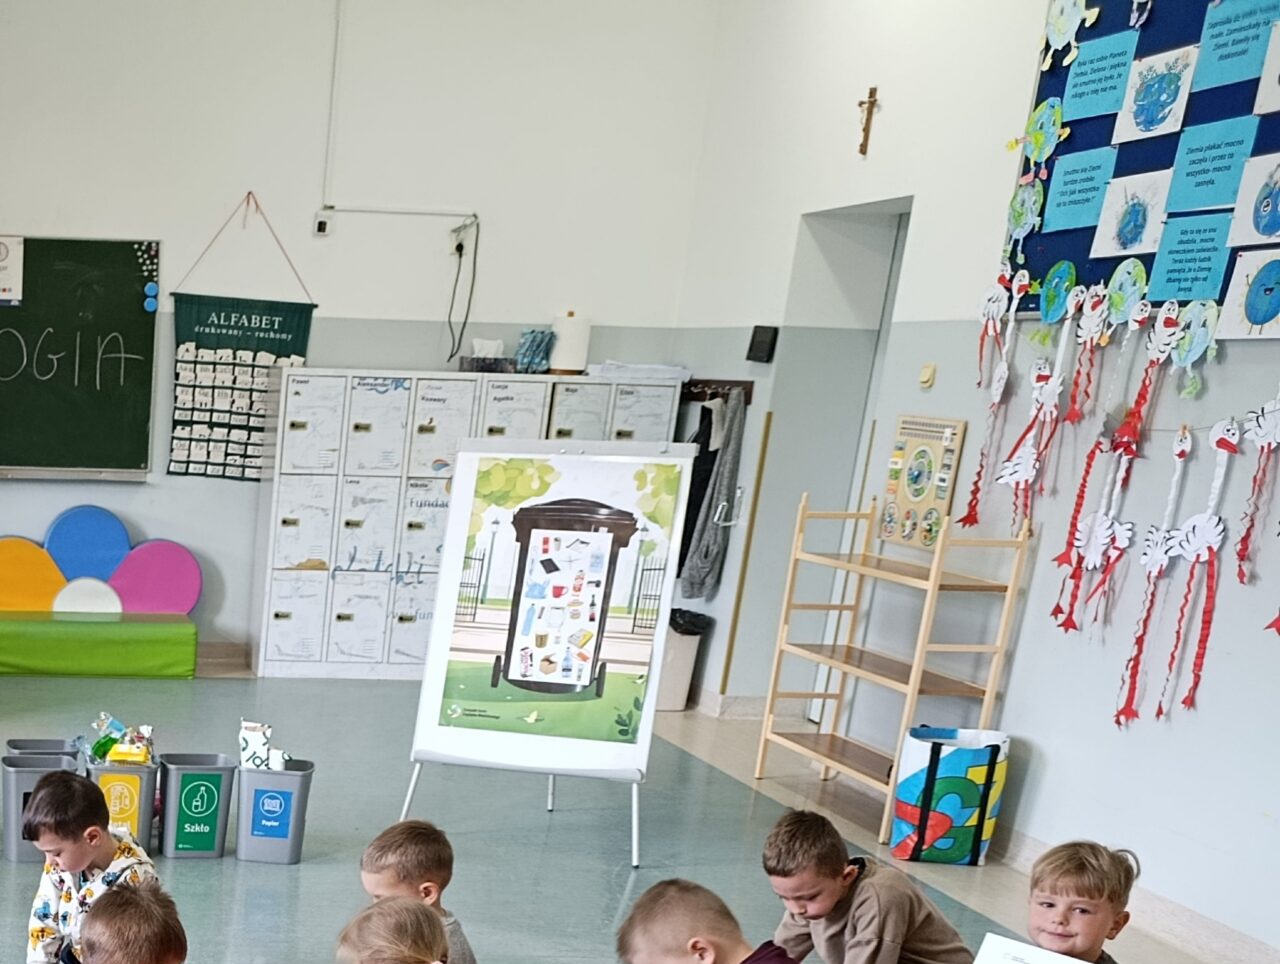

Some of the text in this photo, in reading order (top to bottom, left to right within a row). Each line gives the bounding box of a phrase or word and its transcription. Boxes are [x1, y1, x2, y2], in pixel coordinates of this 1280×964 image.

[207, 311, 283, 330] ALFABET
[194, 325, 243, 337] drukowany
[254, 330, 293, 342] ruchomy
[183, 823, 210, 833] Szkło
[261, 819, 280, 828] Papier
